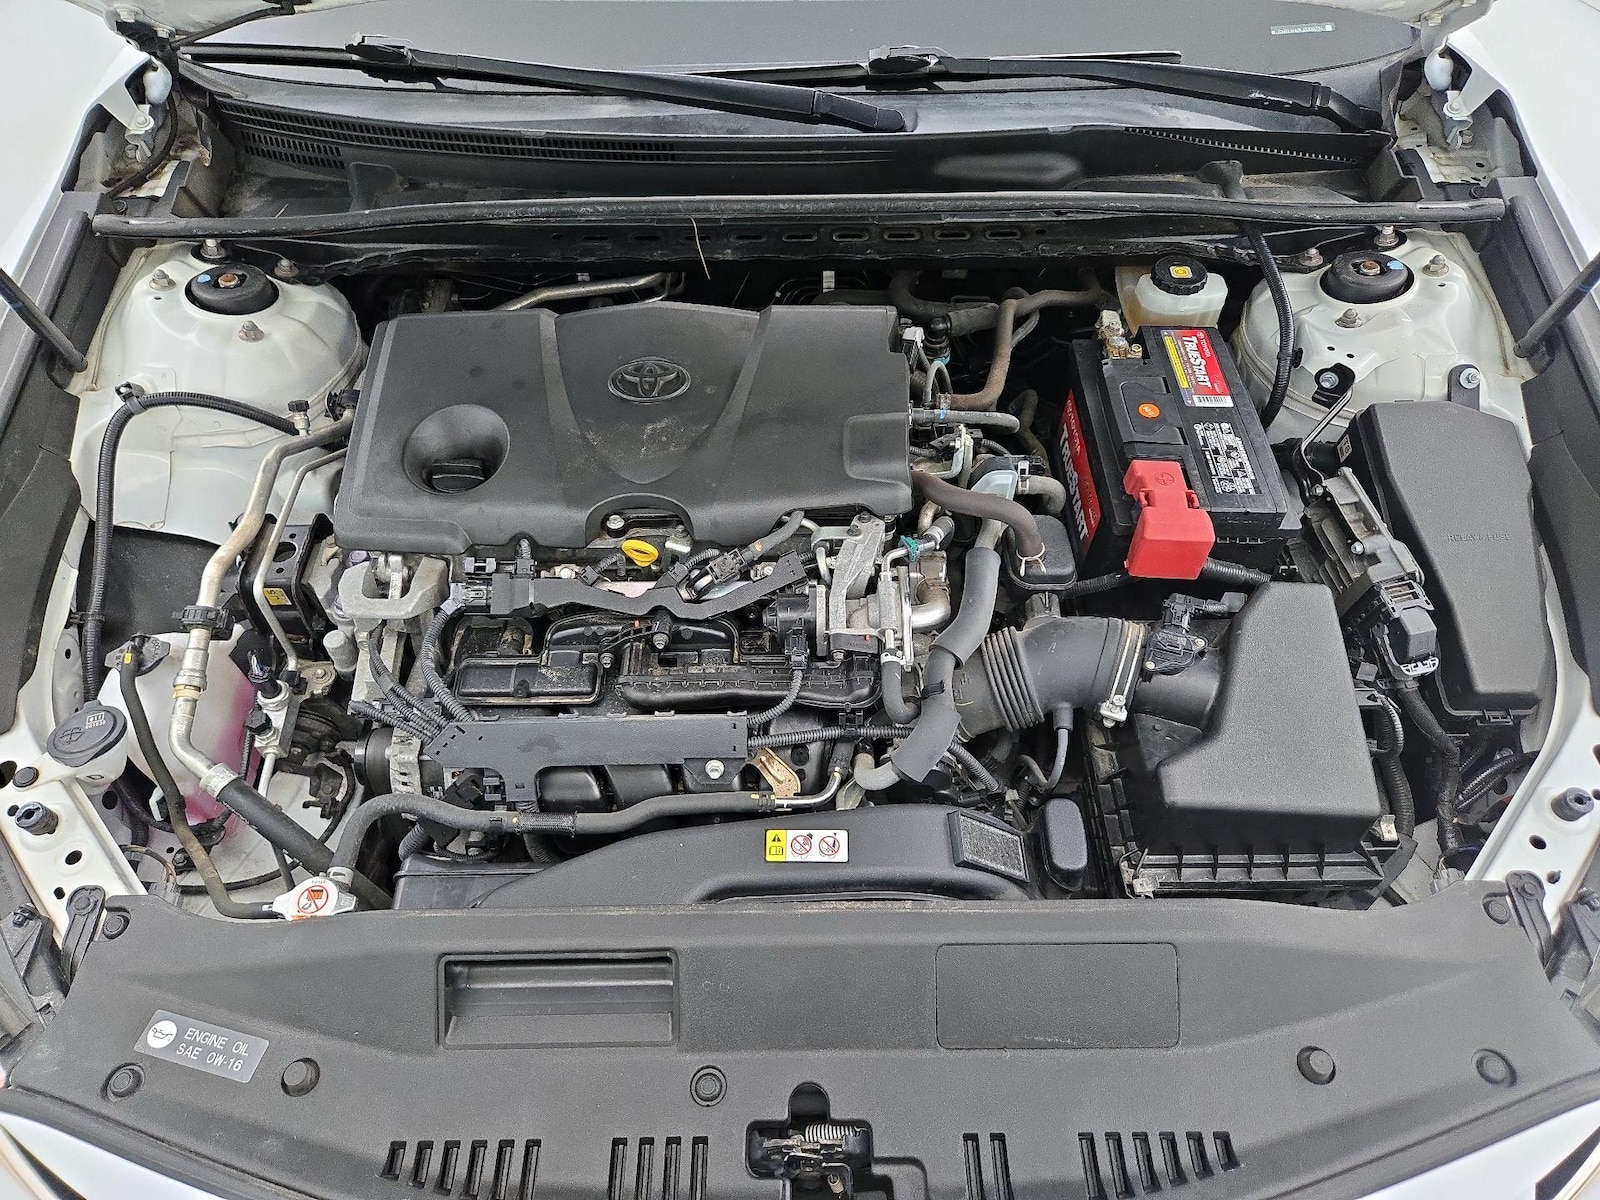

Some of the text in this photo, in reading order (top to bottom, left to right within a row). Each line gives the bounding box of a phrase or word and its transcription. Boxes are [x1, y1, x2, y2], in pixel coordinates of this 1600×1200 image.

[1200, 339, 1211, 358] TOYOTA
[176, 1042, 203, 1060] SAE
[184, 1027, 249, 1057] ENGINE OIL
